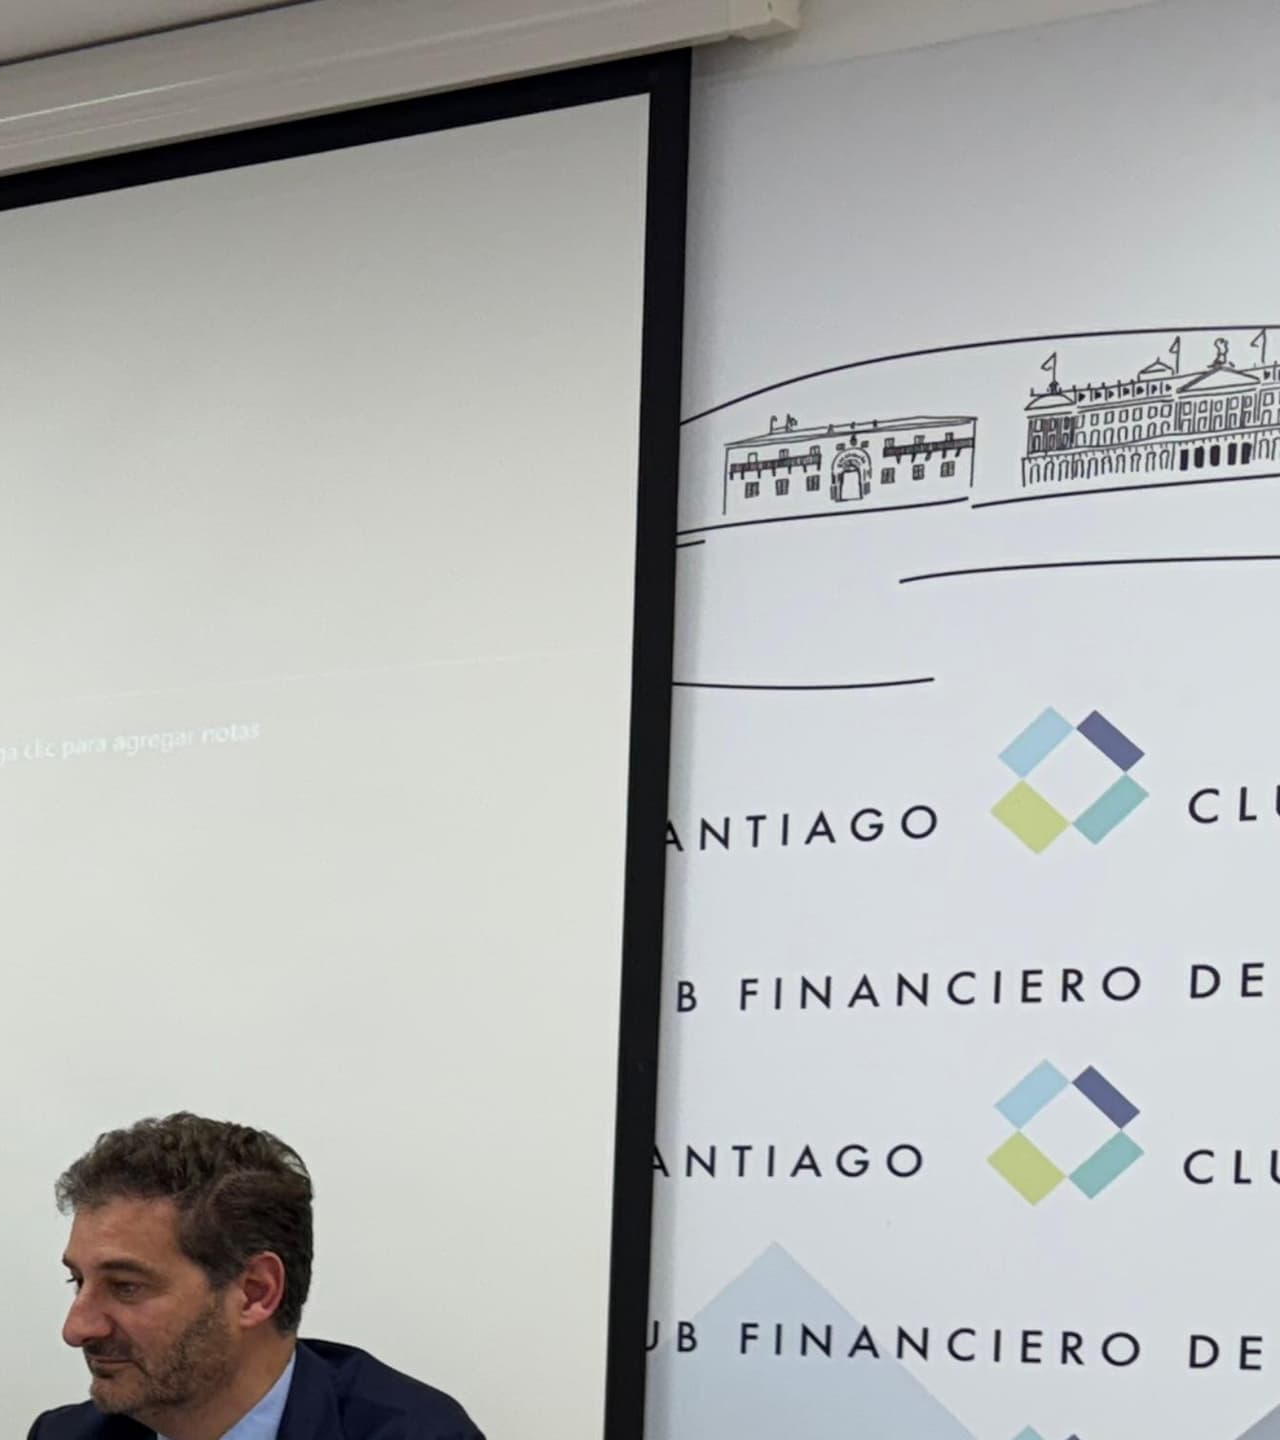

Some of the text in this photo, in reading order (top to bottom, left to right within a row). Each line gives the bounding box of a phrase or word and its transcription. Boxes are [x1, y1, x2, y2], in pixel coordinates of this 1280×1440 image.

[23, 738, 56, 760] clic
[61, 737, 107, 760] para
[112, 729, 195, 757] agregar
[201, 721, 261, 745] notas
[666, 805, 938, 852] ANTIAGO
[739, 965, 1142, 1012] FINANCIERO
[1190, 962, 1265, 999] DE
[653, 1144, 923, 1178] ANTIAGO
[739, 1322, 1141, 1367] FINANCIERO
[1189, 1334, 1264, 1372] DE
